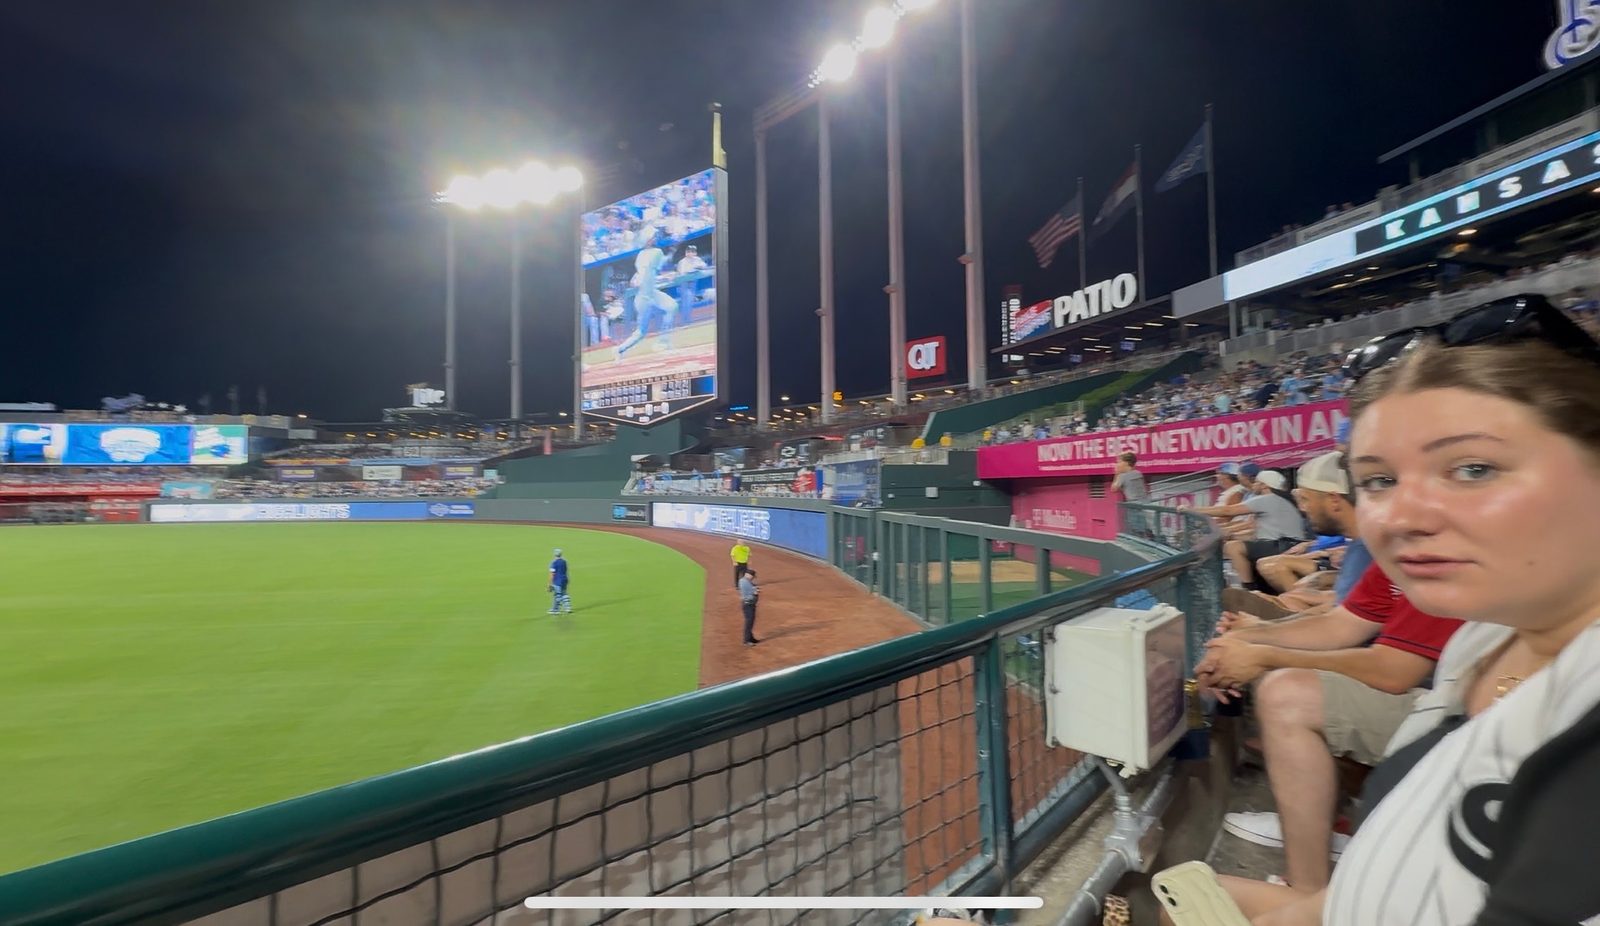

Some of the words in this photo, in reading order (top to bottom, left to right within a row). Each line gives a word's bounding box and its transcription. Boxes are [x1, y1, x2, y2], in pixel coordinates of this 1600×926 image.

[1053, 272, 1137, 328] PATIO
[908, 341, 939, 370] QT
[1037, 441, 1074, 462] NOW
[1074, 438, 1105, 460] THE
[1106, 433, 1148, 458] BEST
[1152, 417, 1268, 455] NETWORK
[1270, 413, 1304, 445] IN
